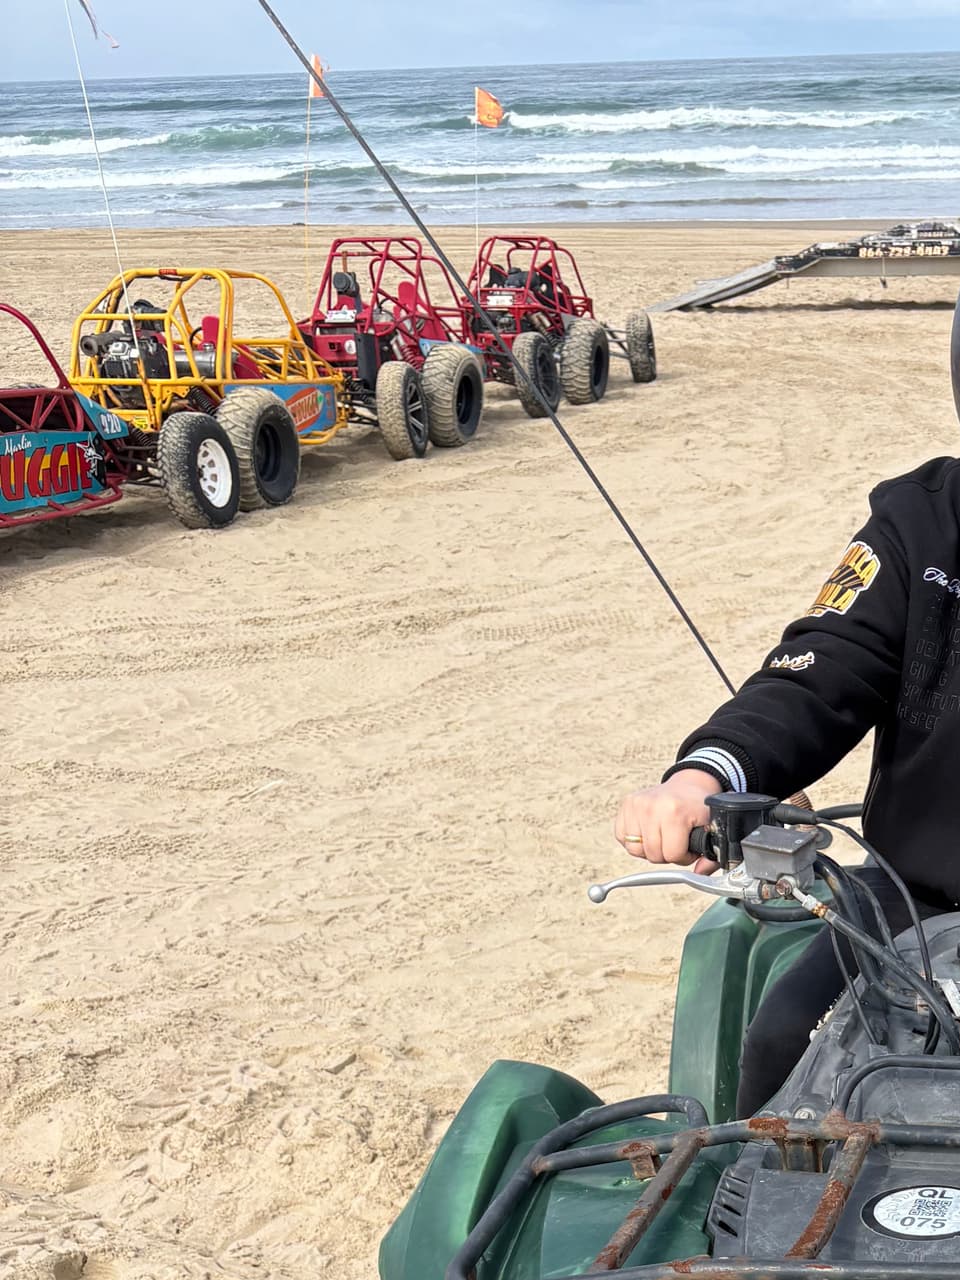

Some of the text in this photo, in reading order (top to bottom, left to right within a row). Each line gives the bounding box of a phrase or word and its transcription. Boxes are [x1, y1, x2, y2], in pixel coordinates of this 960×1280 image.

[4, 434, 32, 455] Marlin
[923, 567, 949, 586] The
[918, 1188, 954, 1200] QL
[899, 1216, 947, 1230] 075
